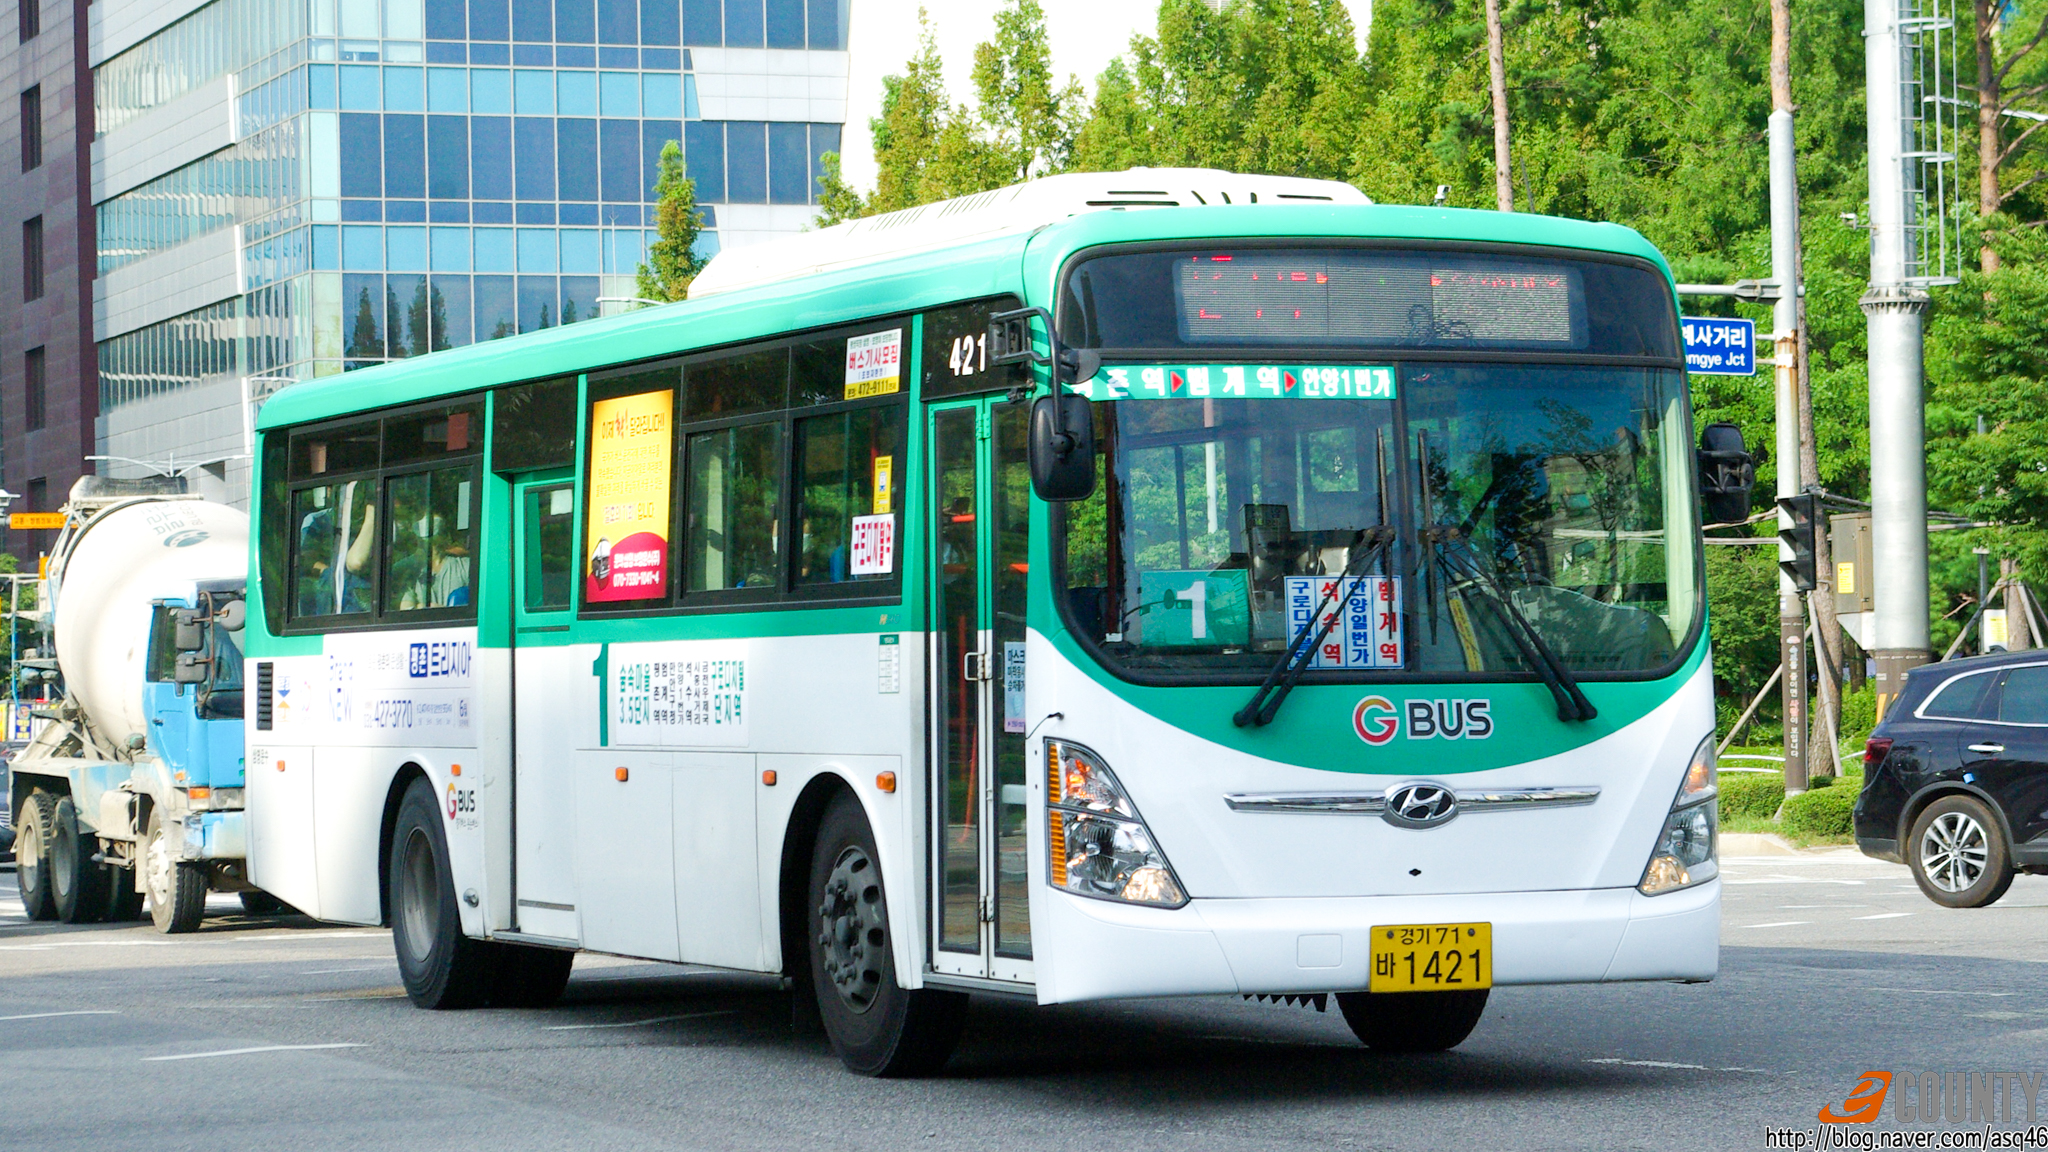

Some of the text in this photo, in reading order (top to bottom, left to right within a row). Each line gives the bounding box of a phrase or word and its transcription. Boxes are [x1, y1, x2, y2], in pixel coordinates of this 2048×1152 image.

[849, 344, 898, 371] 버스기사모집
[949, 333, 987, 377] 421
[1685, 352, 1746, 369] mgye Jct
[858, 381, 888, 395] 472-9111
[1187, 366, 1280, 397] 범계역
[1302, 367, 1391, 398] 안양1번가
[602, 420, 615, 440] 이제
[853, 520, 892, 568] 구로디지털역
[1177, 580, 1207, 639] 1
[1321, 581, 1341, 665] 석수역
[1349, 581, 1370, 664] 안양일번가
[1378, 581, 1398, 664] 범계역
[411, 645, 427, 676] 평촌
[430, 641, 472, 678] 트리지아
[711, 660, 745, 692] 구로디지털
[619, 663, 651, 693] 숲속마을
[592, 643, 609, 747] 1
[714, 693, 742, 725] 단지역
[1404, 699, 1494, 741] BUS
[458, 789, 476, 812] BUS
[1400, 927, 1460, 946] 경기 71
[1376, 949, 1480, 984] 바 1421
